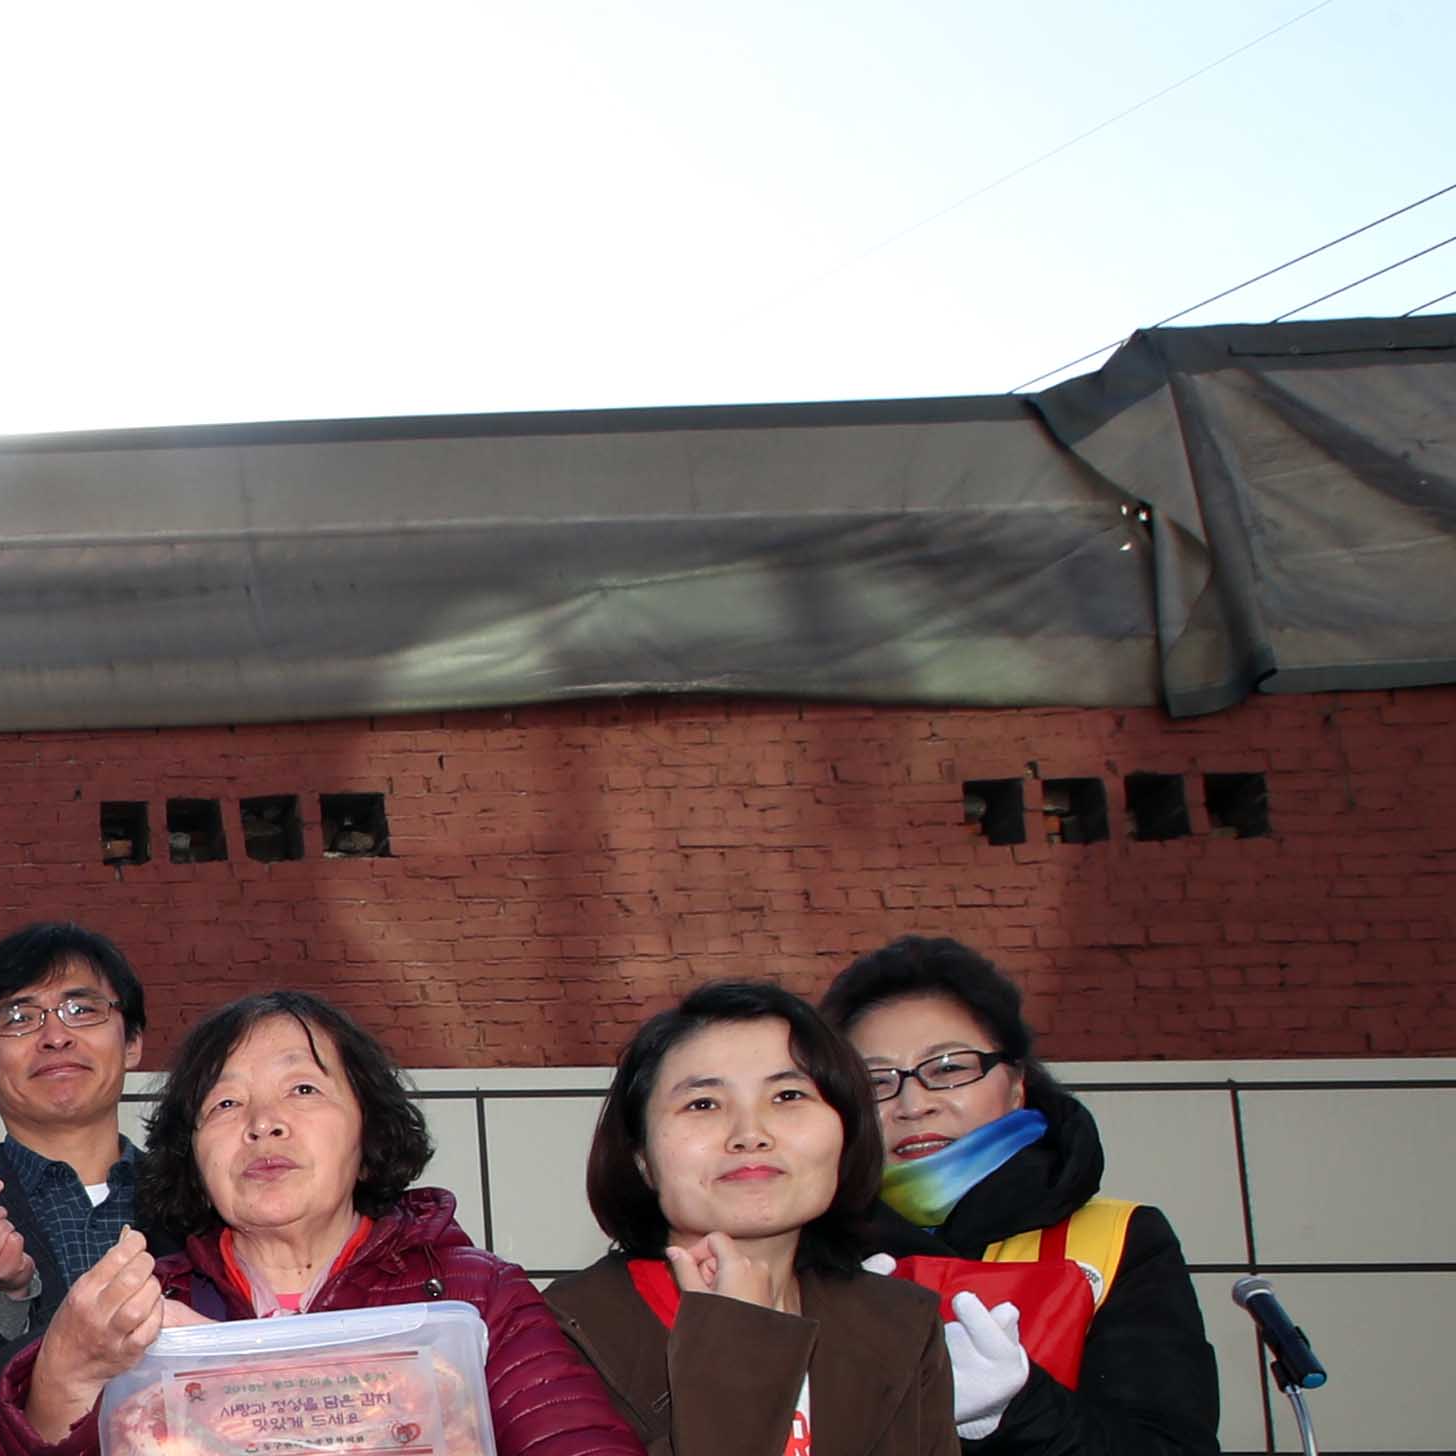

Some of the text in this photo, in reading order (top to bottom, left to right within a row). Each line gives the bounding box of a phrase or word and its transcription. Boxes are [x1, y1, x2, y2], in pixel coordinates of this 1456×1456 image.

[220, 1404, 266, 1418] 사랑과
[322, 1393, 355, 1410] 담은
[359, 1391, 391, 1407] 김치
[251, 1410, 362, 1433] 맛있게 드세요
